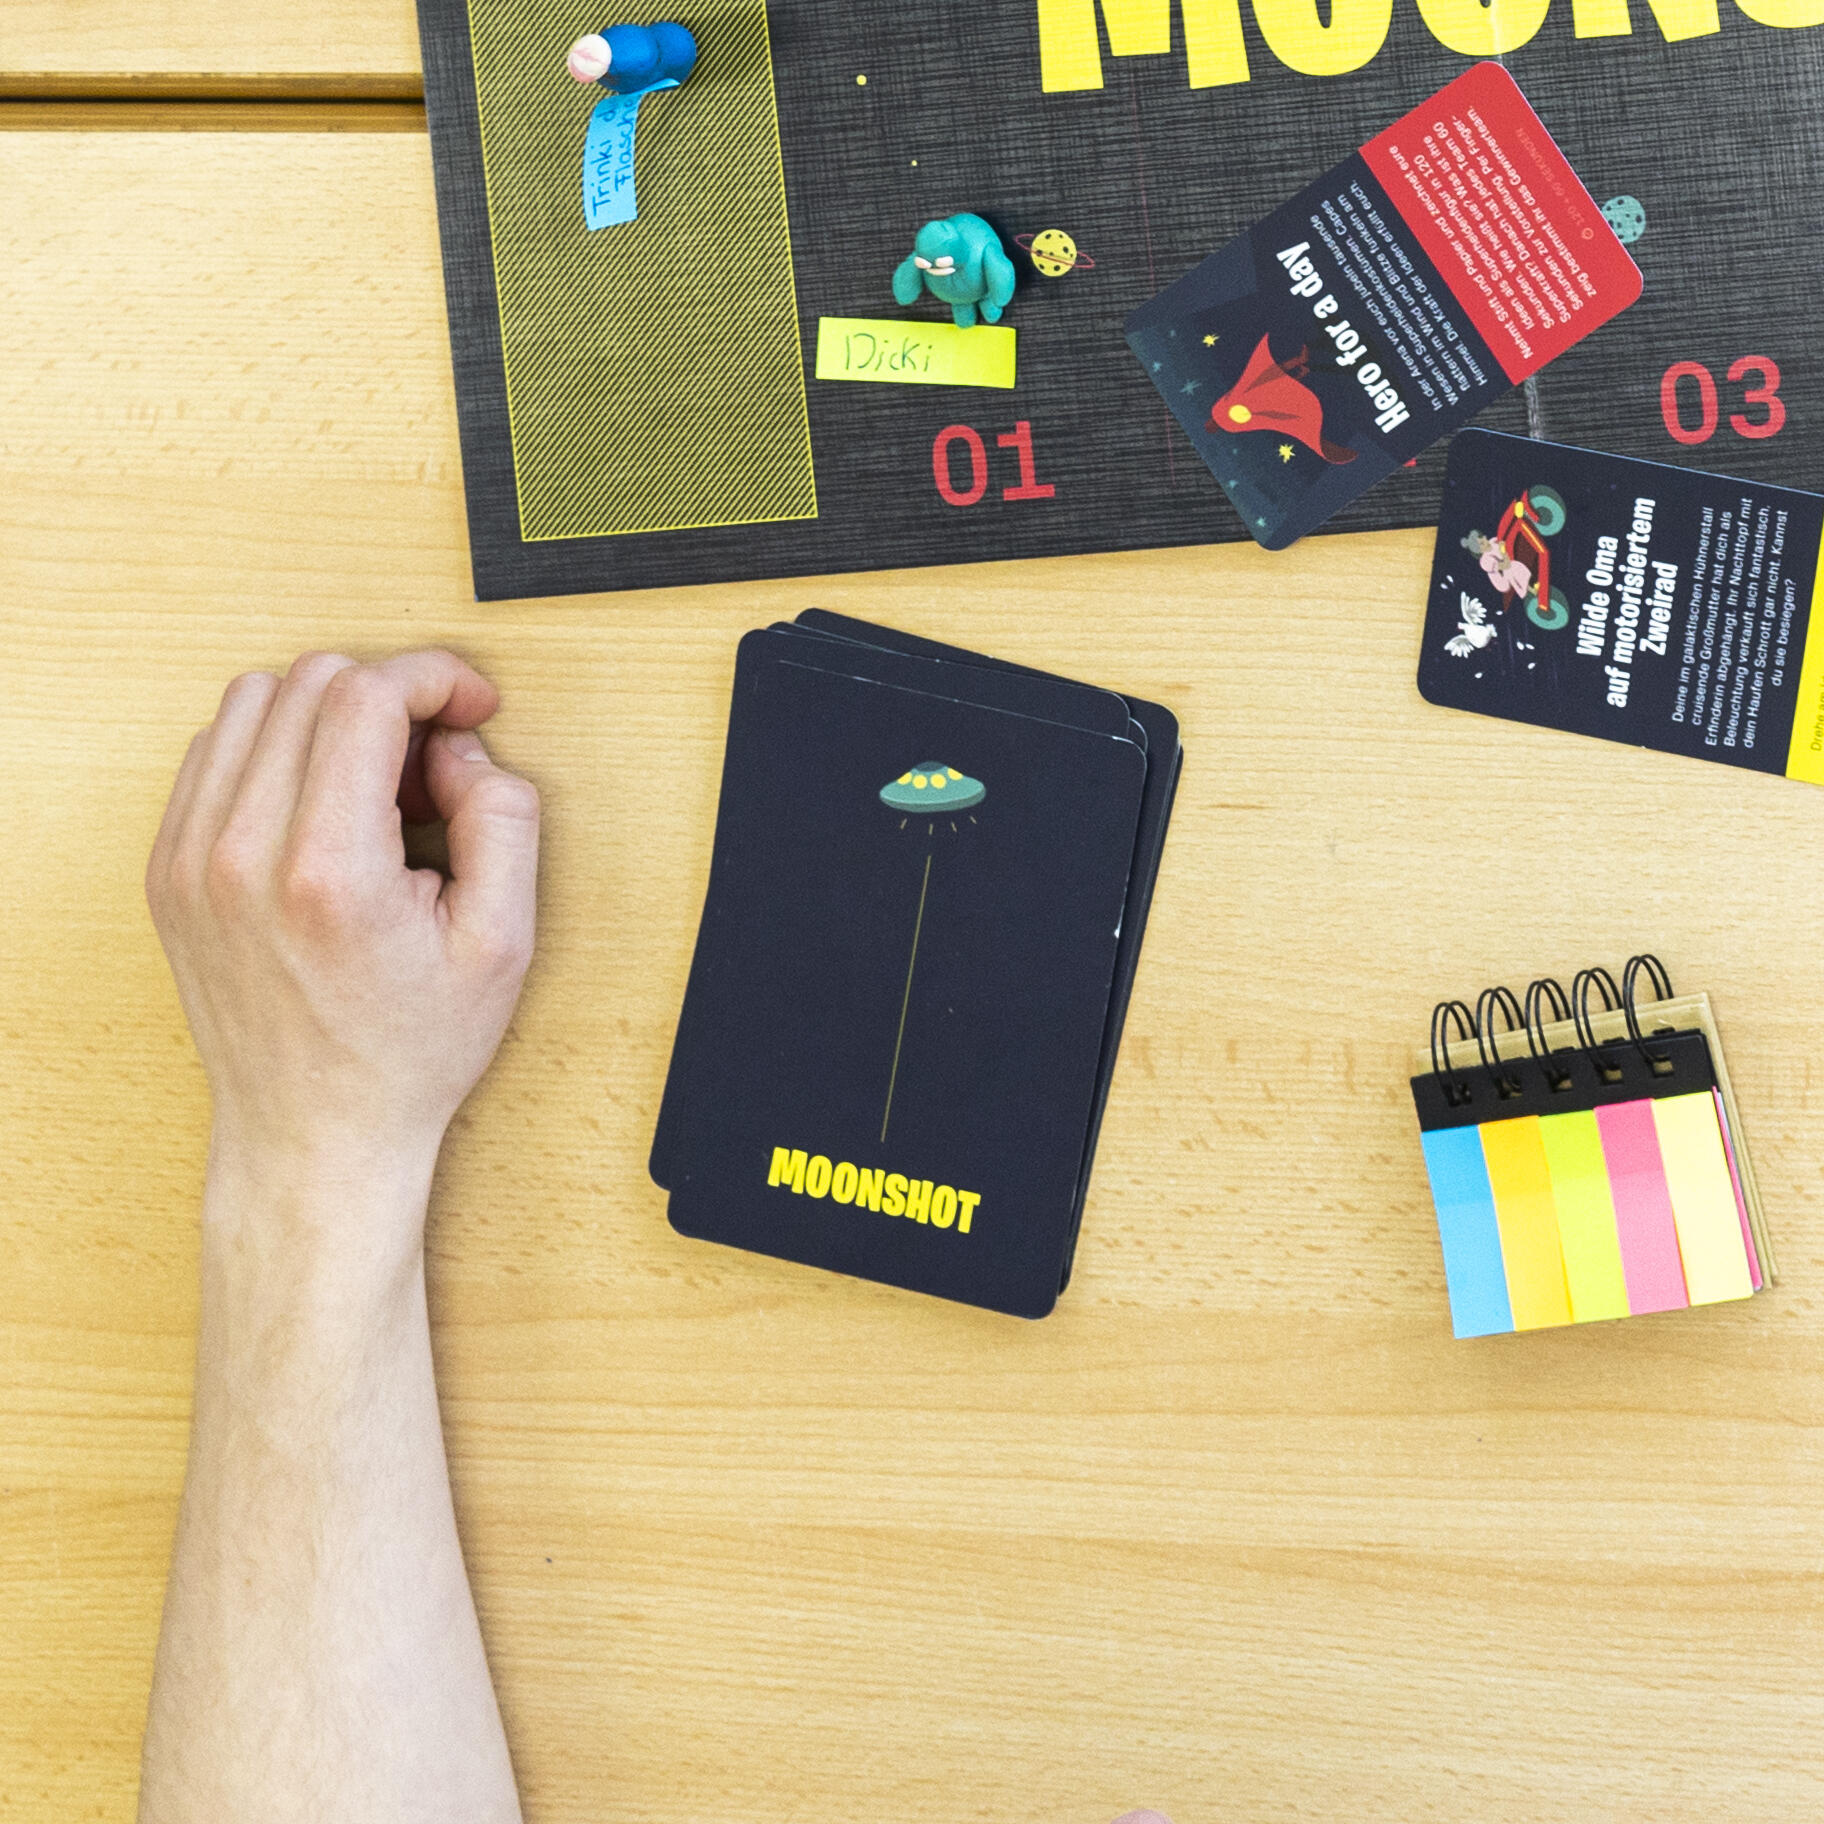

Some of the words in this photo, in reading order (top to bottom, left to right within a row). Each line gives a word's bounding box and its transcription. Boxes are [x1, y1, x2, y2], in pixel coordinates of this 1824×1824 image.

[590, 140, 613, 217] Trinki
[1413, 154, 1434, 178] 120
[1430, 177, 1443, 191] in
[1321, 200, 1347, 236] Capes
[1438, 190, 1503, 281] Superheldenfigur
[1310, 215, 1347, 266] tausende
[1276, 241, 1323, 298] day
[1343, 264, 1372, 299] jubeln
[1499, 279, 1515, 298] als
[1313, 294, 1339, 319] a
[1366, 298, 1387, 326] euch
[1510, 297, 1535, 330] Ideen
[1324, 320, 1368, 367] for
[1384, 327, 1400, 345] vor
[1396, 344, 1422, 377] Arena
[1423, 354, 1435, 367] in
[1357, 362, 1410, 434] Hero
[1417, 379, 1435, 397] der
[1431, 366, 1459, 406] Wesen
[1431, 397, 1443, 411] In
[1660, 357, 1786, 445] 03
[932, 420, 1056, 506] 01
[1720, 511, 1732, 530] als
[1586, 536, 1618, 586] Oma
[1693, 506, 1714, 580] Hühnerstall
[1715, 533, 1729, 561] dich
[1613, 498, 1656, 664] motorisiertem
[1711, 563, 1725, 585] hat
[1639, 561, 1678, 656] Zweirad
[1746, 582, 1758, 608] sich
[1576, 591, 1610, 656] Wilde
[1682, 583, 1703, 664] galaktischen
[1699, 587, 1720, 660] Großmutter
[1739, 611, 1755, 663] verkauft
[1604, 665, 1631, 708] auf
[1679, 667, 1691, 683] im
[1692, 663, 1710, 726] cruisende
[1671, 685, 1688, 723] Deine
[1723, 666, 1749, 747] Beleuchtung
[767, 1146, 981, 1234] MOONSHOT
